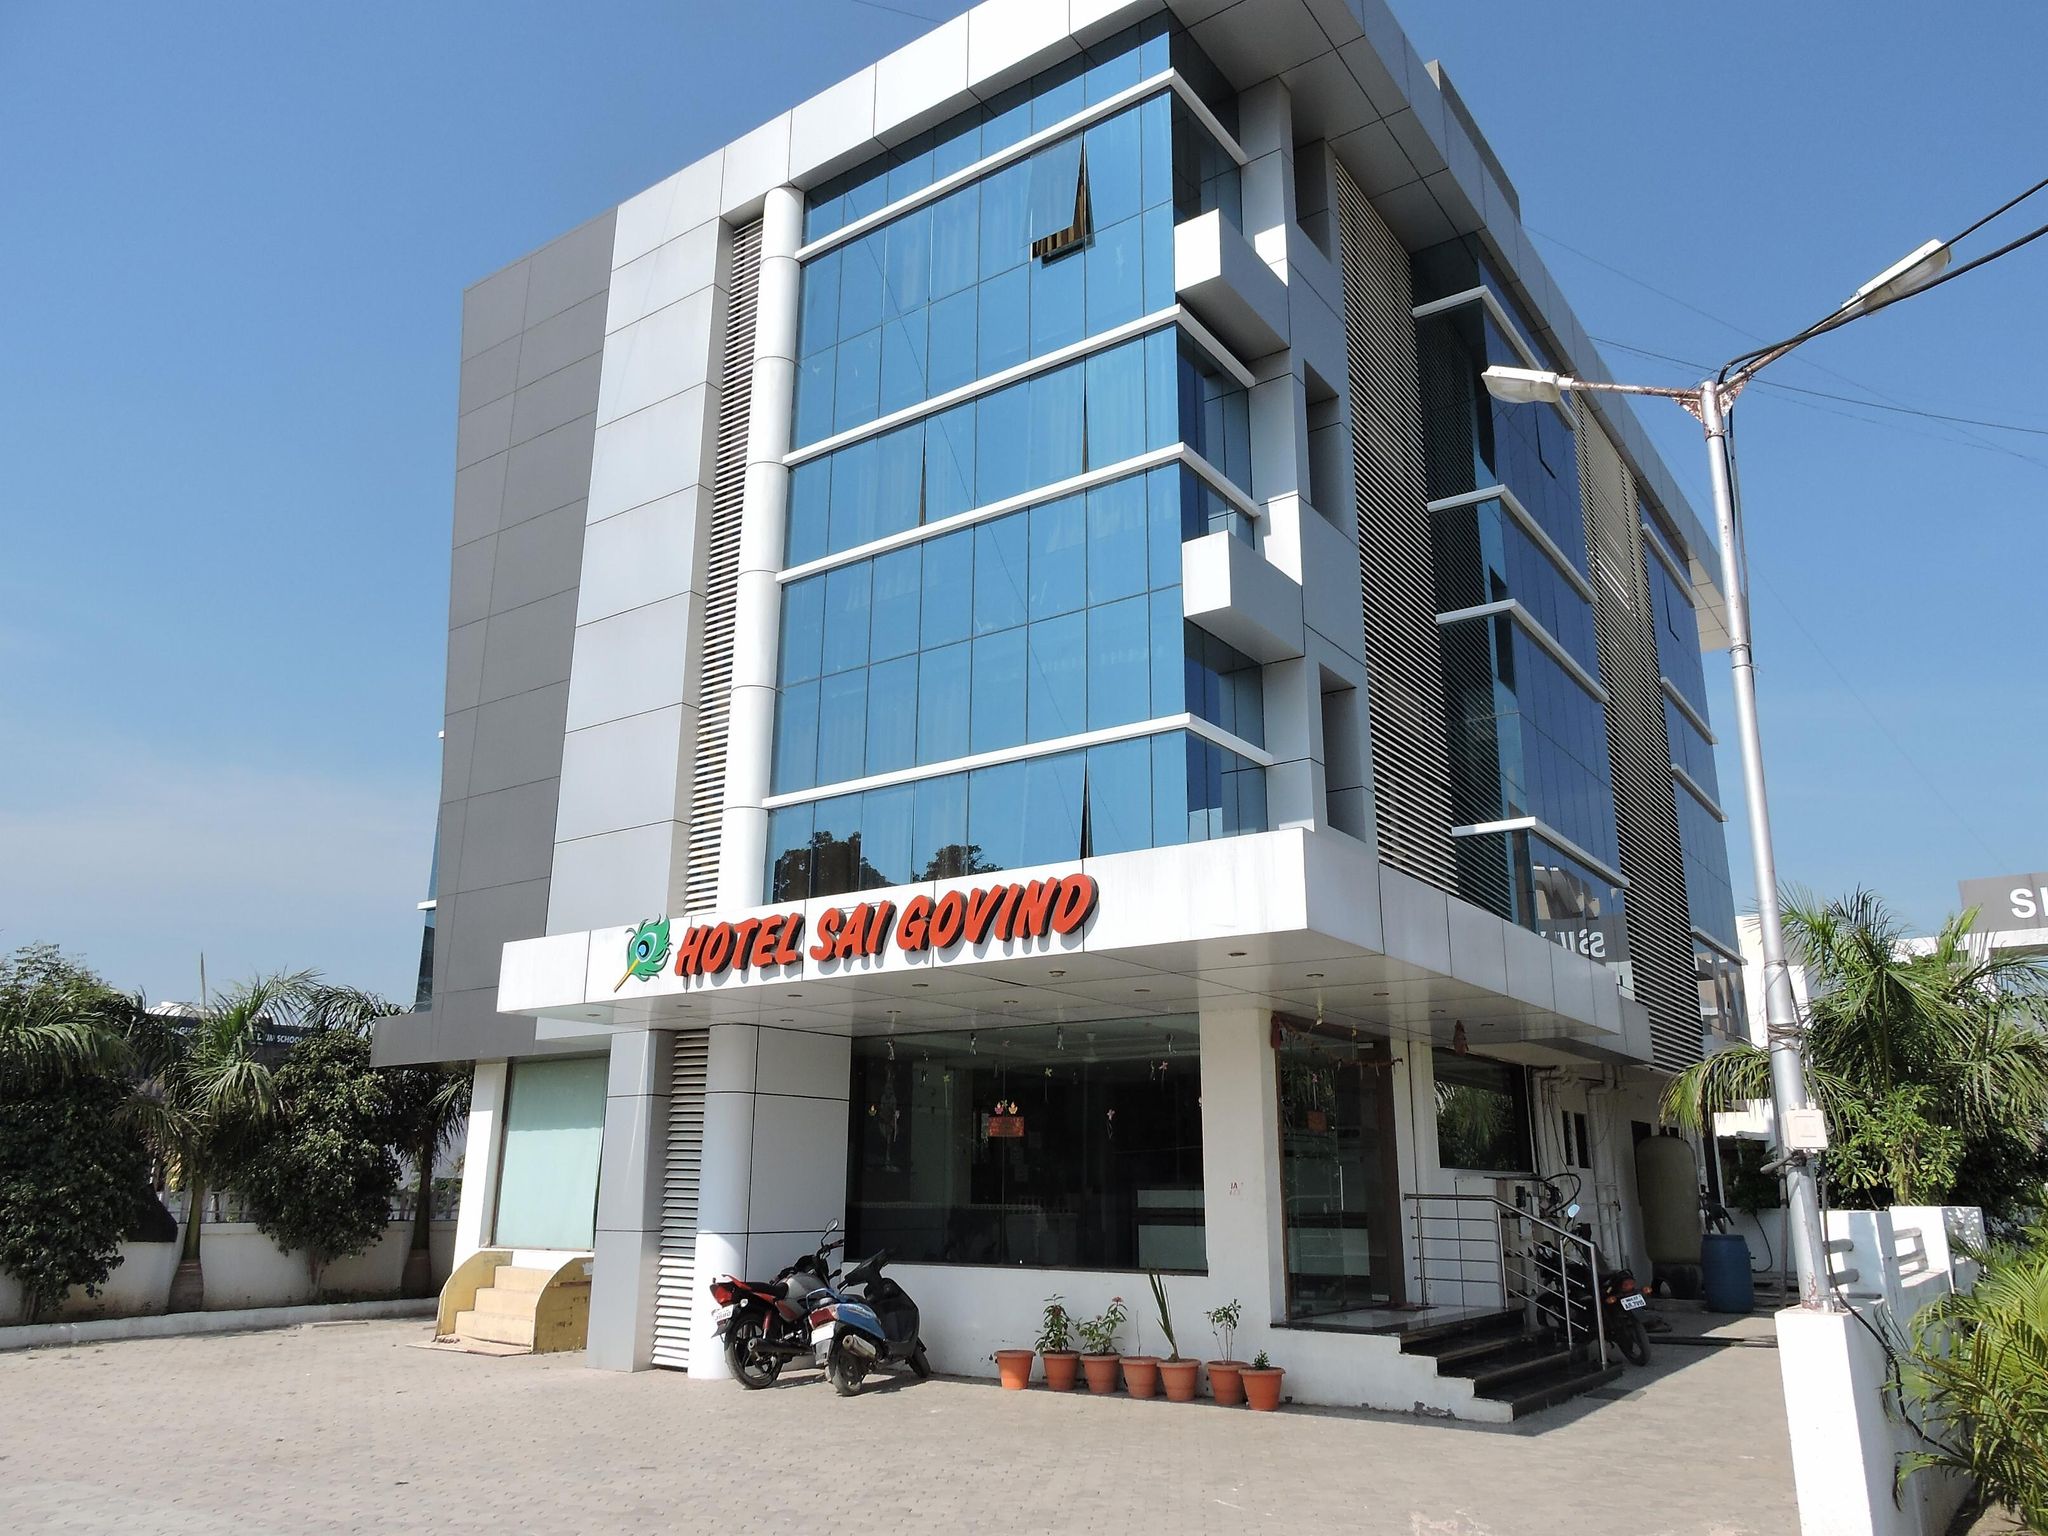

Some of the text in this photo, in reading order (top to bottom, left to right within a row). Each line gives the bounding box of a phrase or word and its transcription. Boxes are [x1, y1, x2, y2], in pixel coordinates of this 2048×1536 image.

[674, 873, 1099, 977] HOTEL SAI GOVIND
